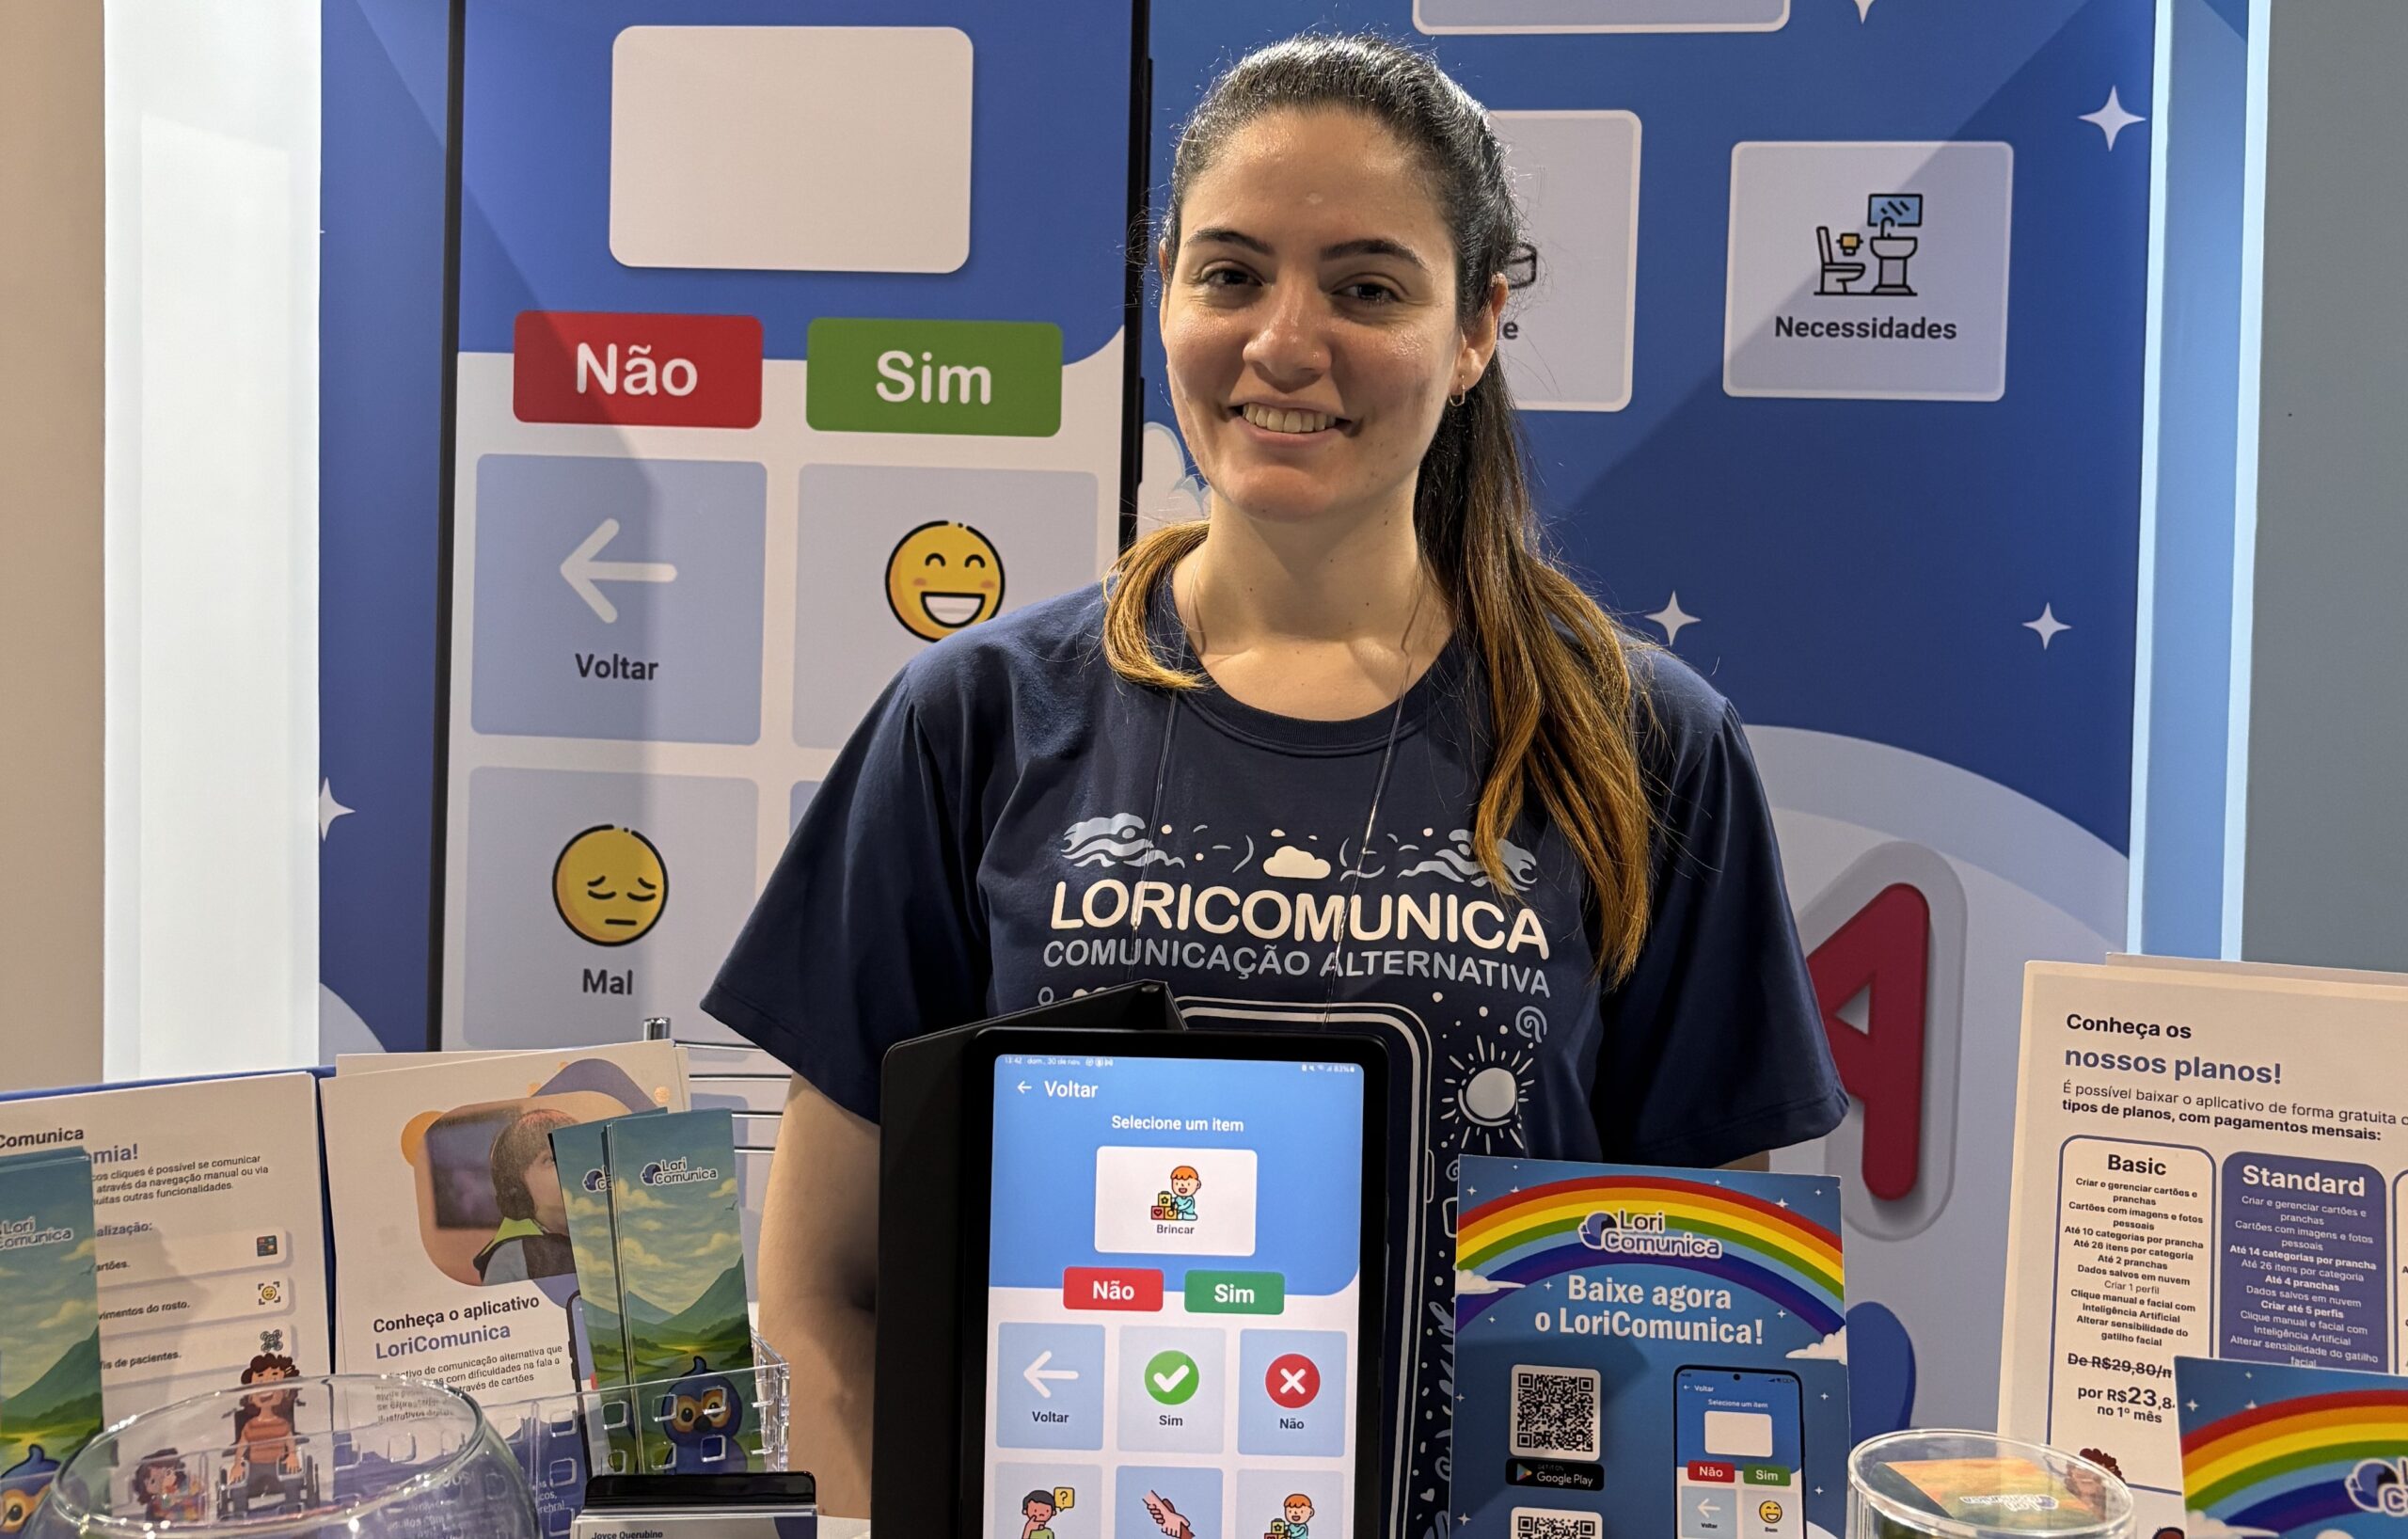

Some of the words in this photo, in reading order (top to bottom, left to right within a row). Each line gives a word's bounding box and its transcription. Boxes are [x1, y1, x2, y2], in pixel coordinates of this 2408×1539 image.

[1775, 315, 1957, 340] Necessidades
[576, 341, 698, 397] Não
[876, 350, 991, 405] Sim
[575, 653, 658, 681] Voltar
[1050, 879, 1550, 960] LORICOMUNICA
[1042, 939, 1311, 981] COMUNICAÇÃO
[1319, 949, 1550, 999] ALTERNATIVA
[582, 969, 634, 996] Mal
[2067, 1014, 2161, 1039] Conheça
[2165, 1024, 2192, 1039] os
[2065, 1049, 2166, 1073] nossos
[2174, 1056, 2281, 1084] planos!
[1044, 1081, 1099, 1098] Voltar
[2064, 1080, 2071, 1093] É
[2075, 1083, 2131, 1101] possível
[2136, 1088, 2178, 1103] baixar
[2182, 1094, 2192, 1105] o
[2196, 1092, 2263, 1112] aplicativo
[2269, 1101, 2287, 1114] de
[2291, 1103, 2334, 1119] forma
[2338, 1106, 2396, 1126] gratuita
[1112, 1116, 1181, 1130] Selecione
[1185, 1119, 1208, 1131] um
[2062, 1100, 2098, 1115] tipos
[2101, 1103, 2119, 1116] de
[2122, 1105, 2176, 1122] planos,
[2179, 1111, 2210, 1123] com
[2214, 1114, 2308, 1134] pagamentos
[2311, 1123, 2381, 1140] mensais:
[111, 1168, 145, 1180] cliques
[148, 1166, 153, 1175] é
[156, 1162, 195, 1176] possível
[212, 1154, 261, 1168] comunicar
[662, 1159, 687, 1171] Lori
[2108, 1154, 2166, 1175] Basic
[97, 1182, 133, 1194] através
[135, 1180, 147, 1188] da
[150, 1173, 201, 1188] navegação
[204, 1168, 239, 1180] manual
[242, 1166, 253, 1175] ou
[655, 1169, 716, 1183] Comunica
[2242, 1166, 2366, 1197] Standard
[123, 1191, 153, 1202] outras
[156, 1182, 233, 1198] funcionalidades.
[2076, 1178, 2098, 1187] Criar
[2108, 1182, 2152, 1193] gerenciar
[2154, 1185, 2189, 1197] cartões
[2113, 1195, 2156, 1205] pranchas
[1621, 1211, 1664, 1232] Lori
[2069, 1202, 2105, 1212] Cartões
[2130, 1210, 2168, 1219] imagens
[2179, 1214, 2203, 1223] fotos
[6, 1216, 35, 1234] Lori
[1156, 1225, 1195, 1234] Brincar
[2113, 1219, 2154, 1230] pessoais
[1605, 1233, 1720, 1257] Comunica
[2096, 1230, 2144, 1242] categorias
[2165, 1238, 2204, 1248] prancha
[2106, 1244, 2129, 1252] itens
[2131, 1246, 2147, 1255] por
[2149, 1248, 2194, 1261] categoria
[2078, 1264, 2107, 1275] Dados
[2110, 1269, 2139, 1278] salvos
[2159, 1276, 2190, 1285] nuvem
[2124, 1259, 2167, 1270] pranchas
[1093, 1280, 1134, 1301] Não
[1214, 1284, 1255, 1304] Sim
[1569, 1275, 1644, 1304] Baixe
[1653, 1282, 1731, 1312] agora
[2104, 1280, 2126, 1290] Criar
[2136, 1285, 2159, 1294] perfil
[147, 1305, 159, 1313] do
[162, 1301, 189, 1311] rosto.
[2071, 1290, 2100, 1300] Clique
[2103, 1293, 2137, 1304] manual
[2147, 1299, 2172, 1309] facial
[373, 1313, 444, 1333] Conheça
[450, 1309, 458, 1321] o
[464, 1296, 540, 1319] aplicativo
[2083, 1304, 2137, 1316] Inteligência
[2140, 1310, 2179, 1323] Artificial
[1535, 1312, 1550, 1332] o
[1560, 1309, 1763, 1345] LoriComunica!
[2077, 1315, 2108, 1325] Alterar
[2111, 1320, 2174, 1335] sensibilidade
[2177, 1328, 2188, 1337] do
[376, 1325, 511, 1359] LoriComunica
[2101, 1332, 2133, 1341] gatilho
[2136, 1337, 2162, 1346] facial
[115, 1358, 127, 1368] de
[130, 1352, 181, 1367] pacientes.
[425, 1366, 436, 1374] de
[438, 1355, 498, 1372] comunicação
[499, 1347, 544, 1362] alternativa
[547, 1345, 562, 1356] que
[2067, 1353, 2087, 1366] De
[446, 1373, 466, 1384] com
[468, 1365, 521, 1380] dificuldades
[536, 1358, 550, 1367] fala
[488, 1379, 499, 1388] de
[501, 1373, 534, 1386] cartões
[2078, 1388, 2103, 1399] por
[2107, 1387, 2175, 1410] R$23,8
[1032, 1411, 1069, 1423] Voltar
[1159, 1415, 1183, 1426] Sim
[1279, 1418, 1304, 1430] Não
[2098, 1406, 2114, 1416] no
[2133, 1411, 2162, 1423] mês
[1537, 1471, 1572, 1485] Google
[1574, 1474, 1593, 1487] Play
[1699, 1466, 1723, 1478] Não
[1756, 1470, 1778, 1481] Sim
[620, 1531, 663, 1539] Querubino
